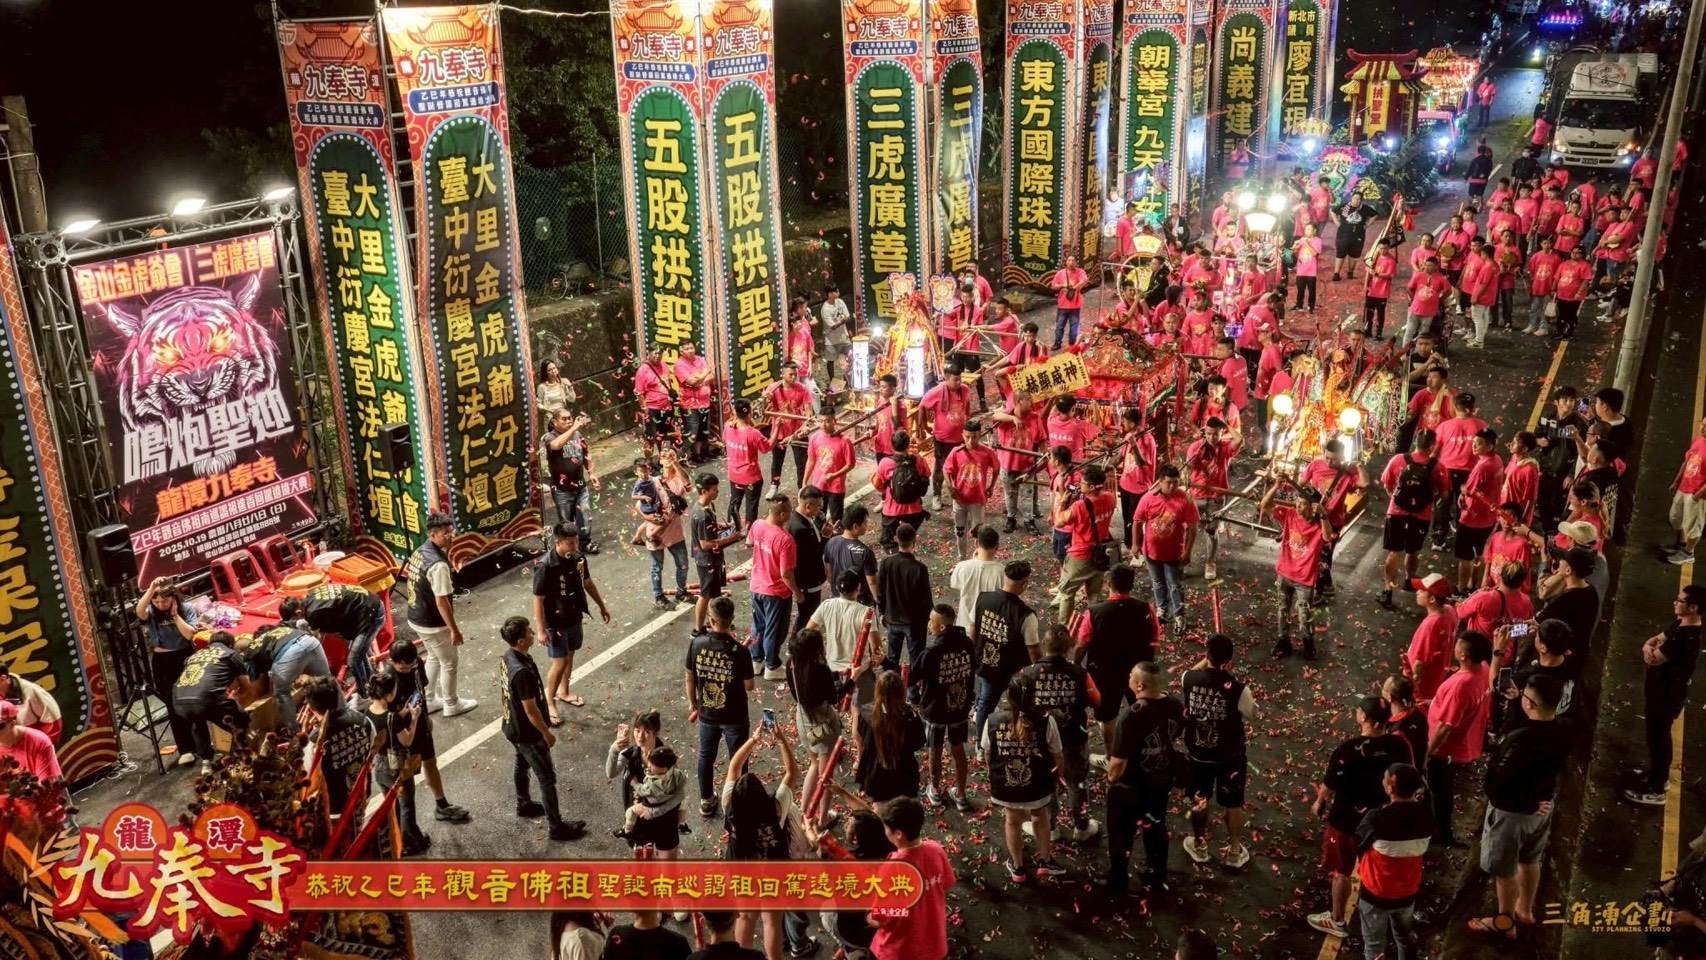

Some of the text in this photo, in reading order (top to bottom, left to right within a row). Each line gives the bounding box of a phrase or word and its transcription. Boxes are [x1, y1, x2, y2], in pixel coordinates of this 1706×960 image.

[860, 16, 909, 39] 九奉寺
[1019, 2, 1063, 20] 九奉寺
[1288, 10, 1316, 22] 新北市
[419, 47, 487, 84] 九奉寺
[633, 33, 682, 60] 九奉寺
[716, 27, 759, 55] 九奉寺
[305, 66, 368, 98] 九奉寺
[1018, 59, 1055, 261] 東方國際珠寶
[78, 235, 275, 301] 金山金虎爺會 三虎廣善會
[724, 112, 774, 398] 五股拱聖堂
[353, 173, 421, 535] 大里金虎爺會
[438, 157, 493, 514] 臺中衍慶宮法仁壇
[471, 153, 519, 505] 大里金虎爺分會
[124, 389, 295, 484] 鳴炮聖迎
[157, 456, 278, 520] 龍潭九奉寺
[159, 530, 206, 557] 2025.10.19
